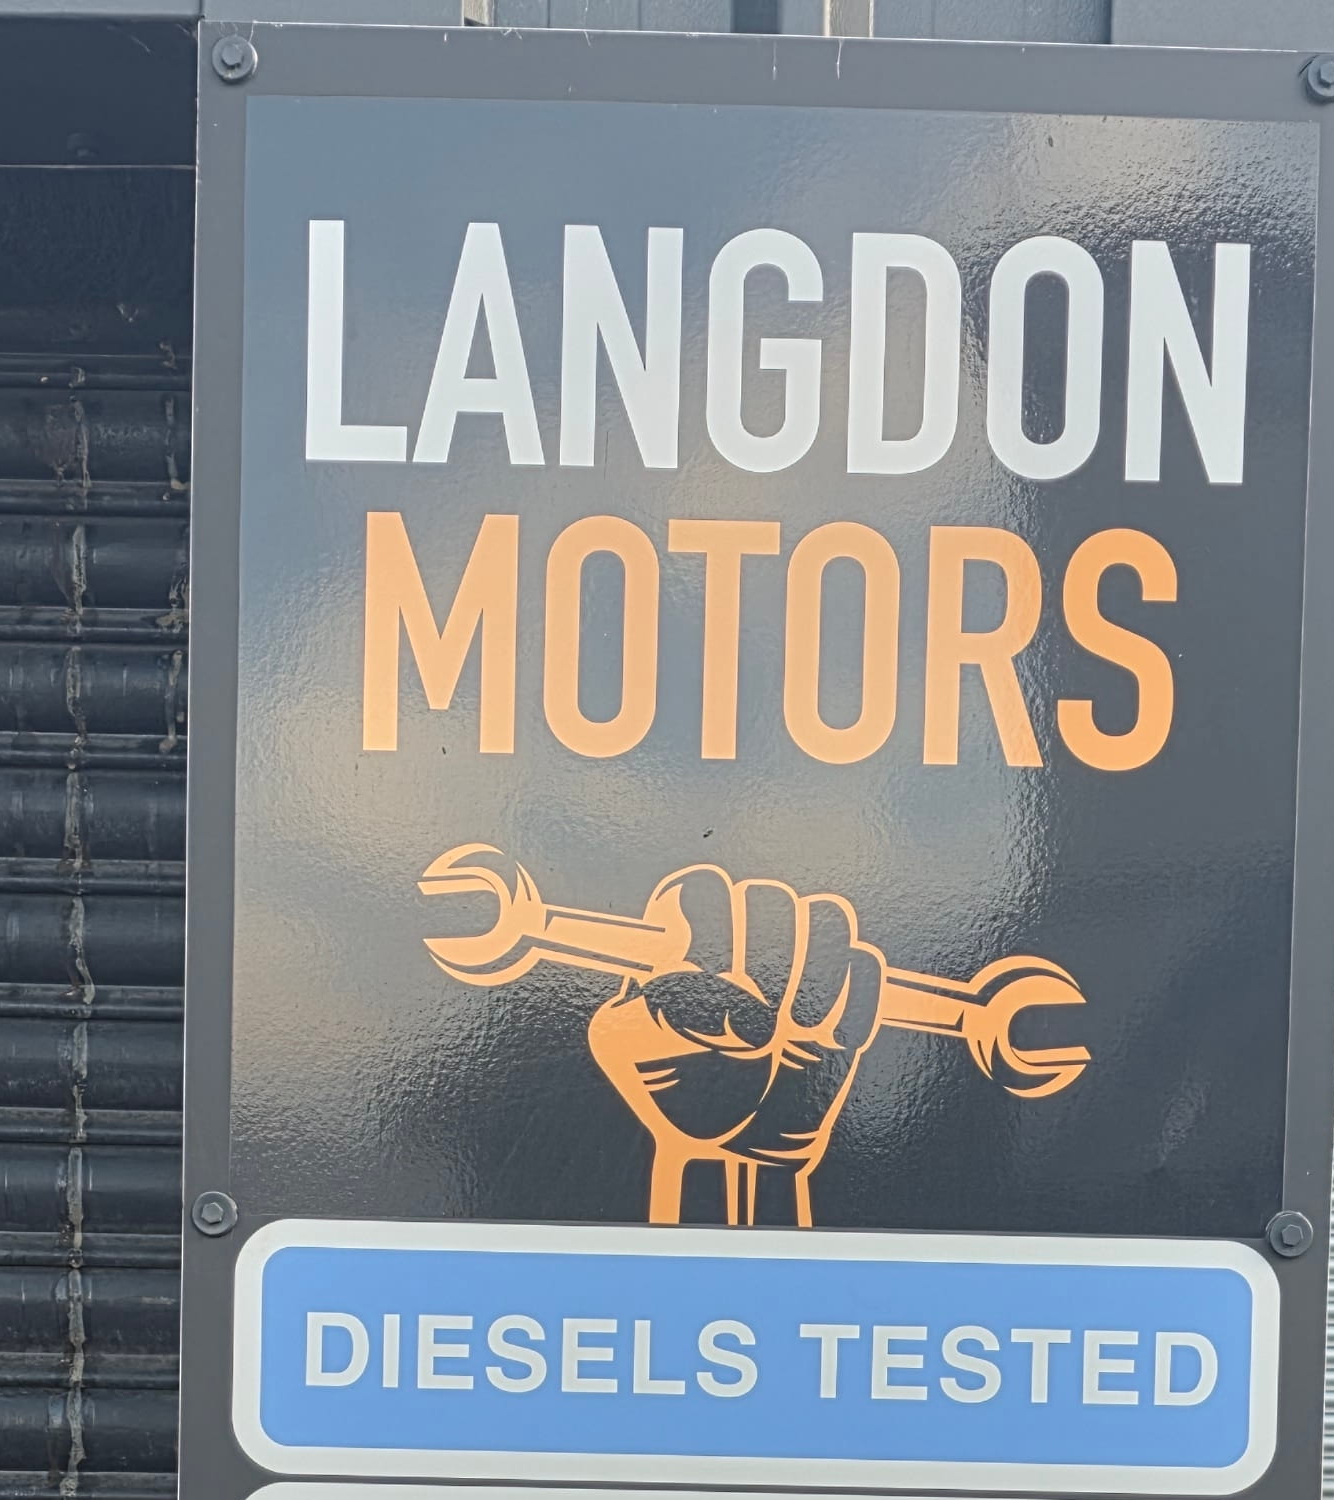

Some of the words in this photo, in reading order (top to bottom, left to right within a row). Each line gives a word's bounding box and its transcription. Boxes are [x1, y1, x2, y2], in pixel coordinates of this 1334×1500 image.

[304, 218, 1253, 486] LANGDON
[361, 510, 1180, 773] MOTORS
[303, 1310, 760, 1399] DIESELS
[799, 1322, 1221, 1408] TESTED
